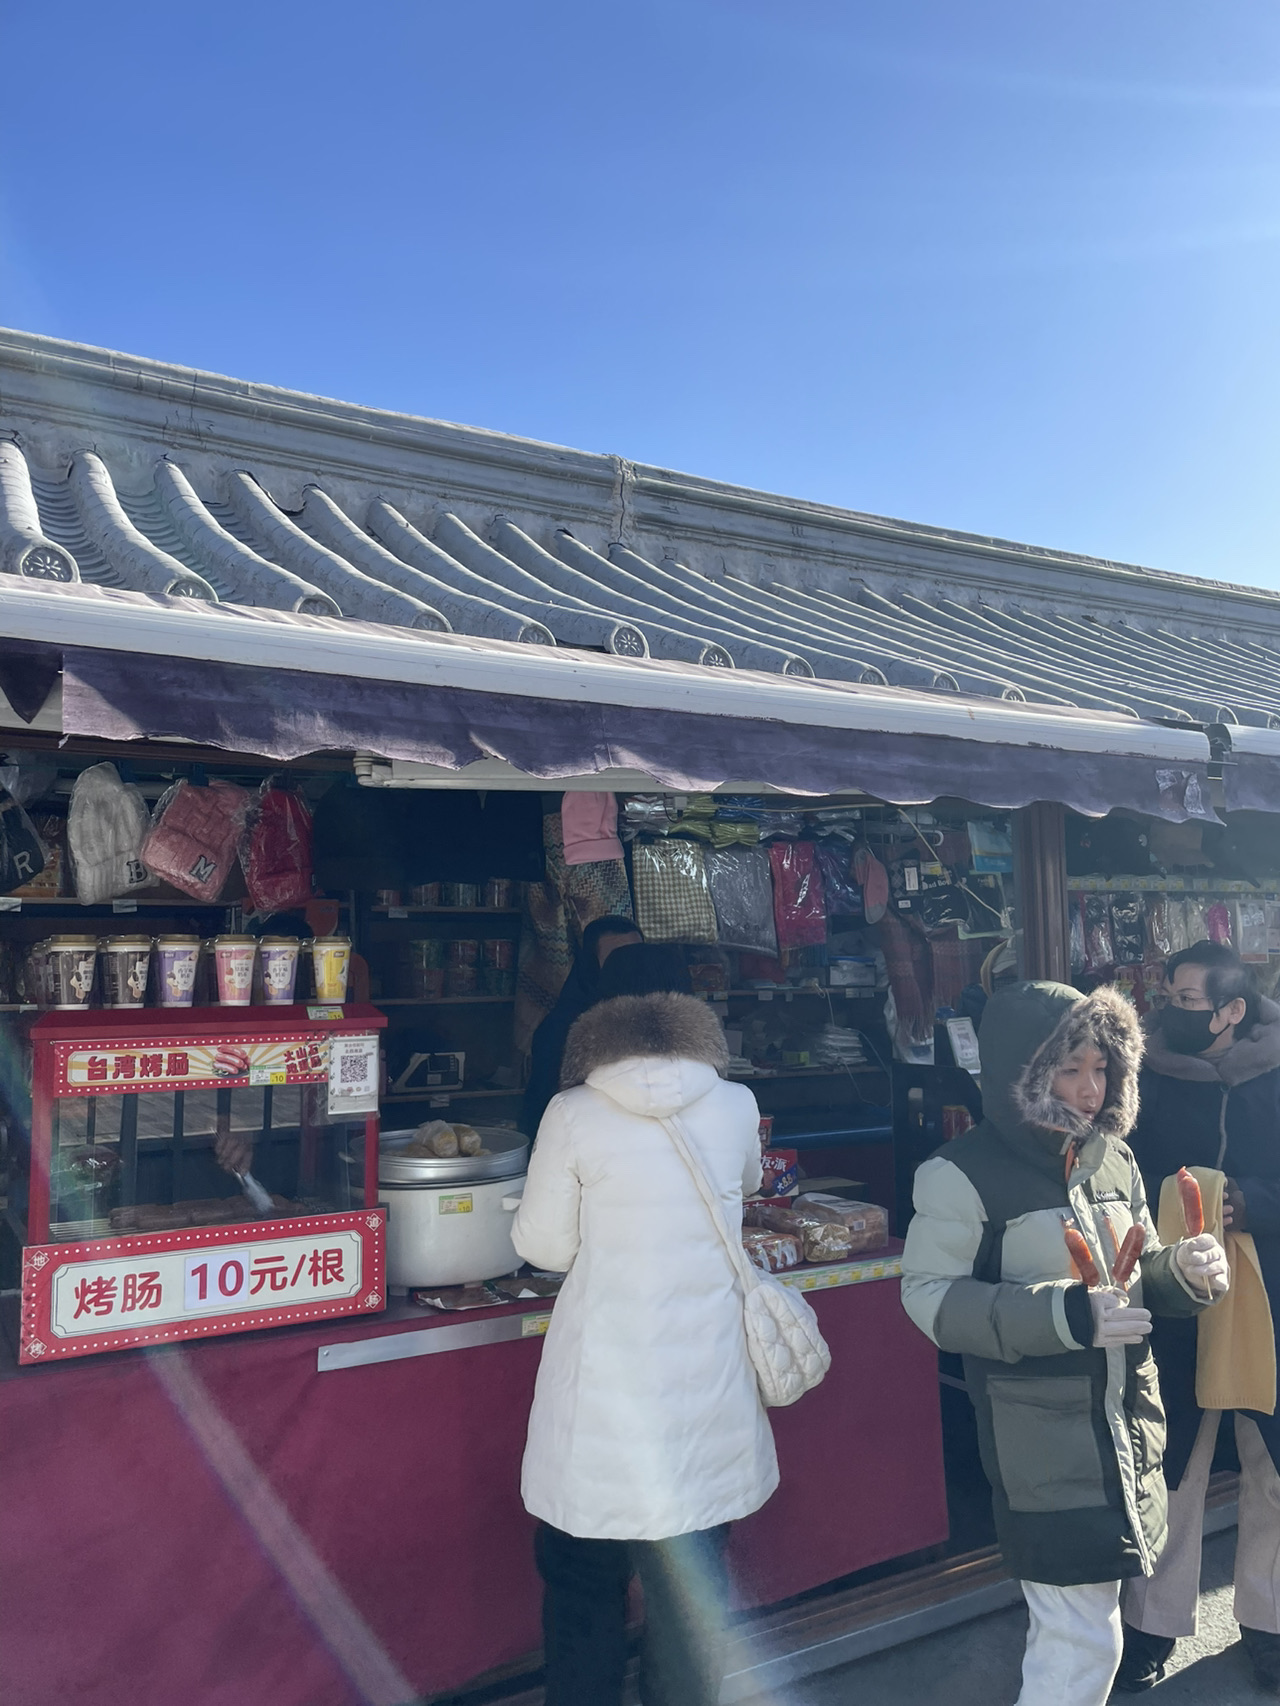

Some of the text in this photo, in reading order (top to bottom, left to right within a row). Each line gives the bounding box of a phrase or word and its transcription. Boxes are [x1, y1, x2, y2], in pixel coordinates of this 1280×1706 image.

[13, 851, 34, 880] R
[126, 859, 148, 884] B
[189, 854, 217, 884] M
[87, 1052, 190, 1081] 台湾烤肠
[283, 1043, 319, 1063] 火山石
[73, 1248, 345, 1320] 烤肠 10元/根
